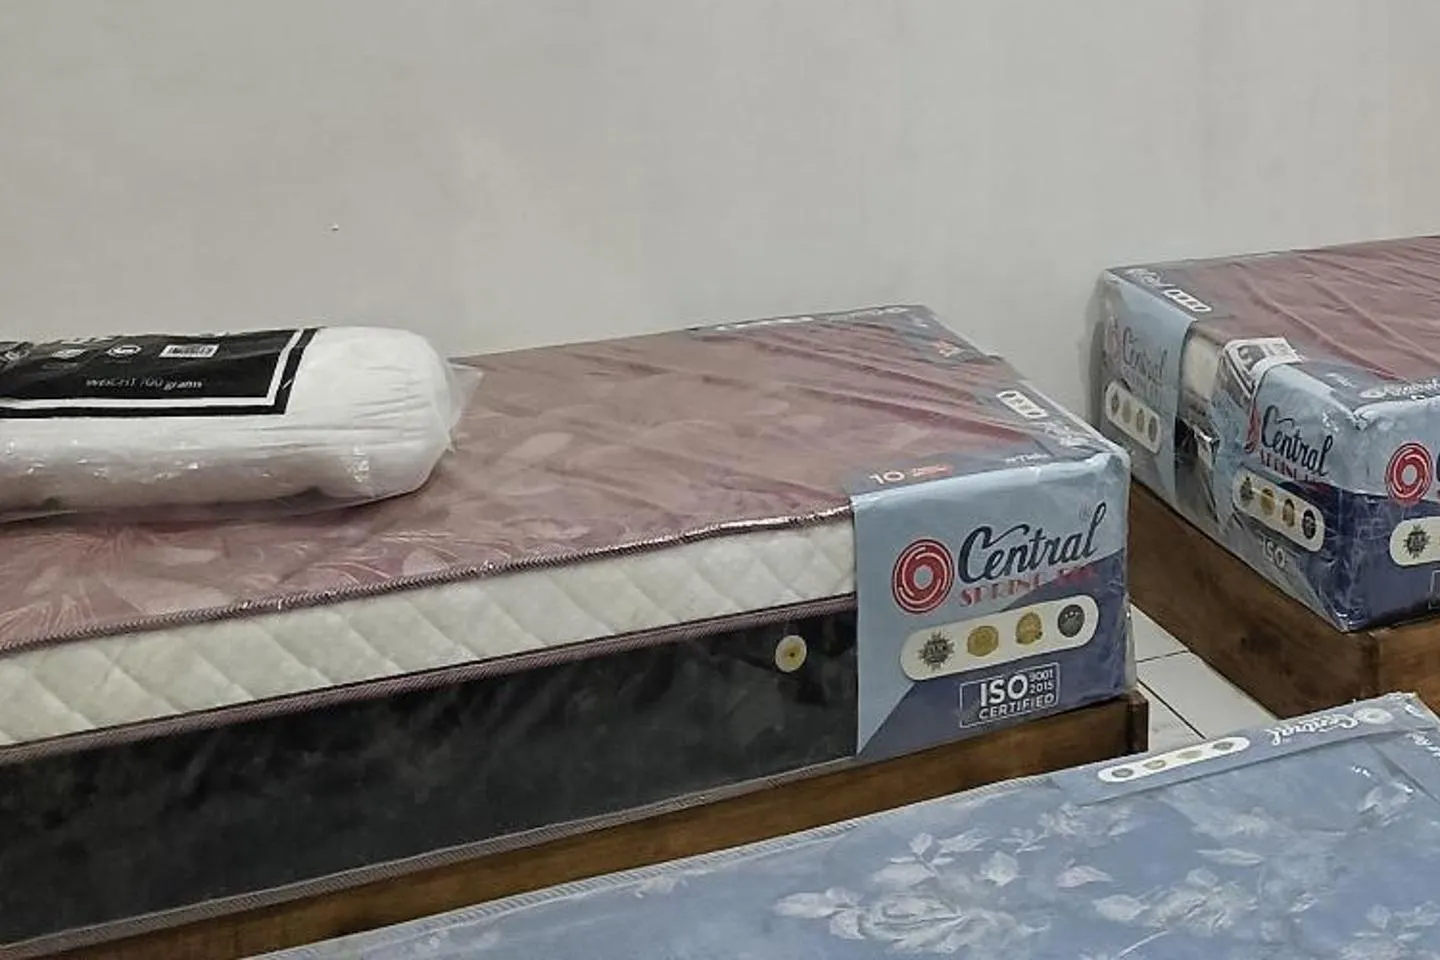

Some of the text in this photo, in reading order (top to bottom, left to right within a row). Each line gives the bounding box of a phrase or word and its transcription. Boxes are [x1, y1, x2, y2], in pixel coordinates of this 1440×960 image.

[1260, 404, 1333, 477] Central
[869, 471, 905, 485] 10
[957, 502, 1107, 583] Central
[979, 673, 1029, 707] ISO
[1029, 681, 1054, 694] 2015
[978, 693, 1055, 720] CERTIFIED
